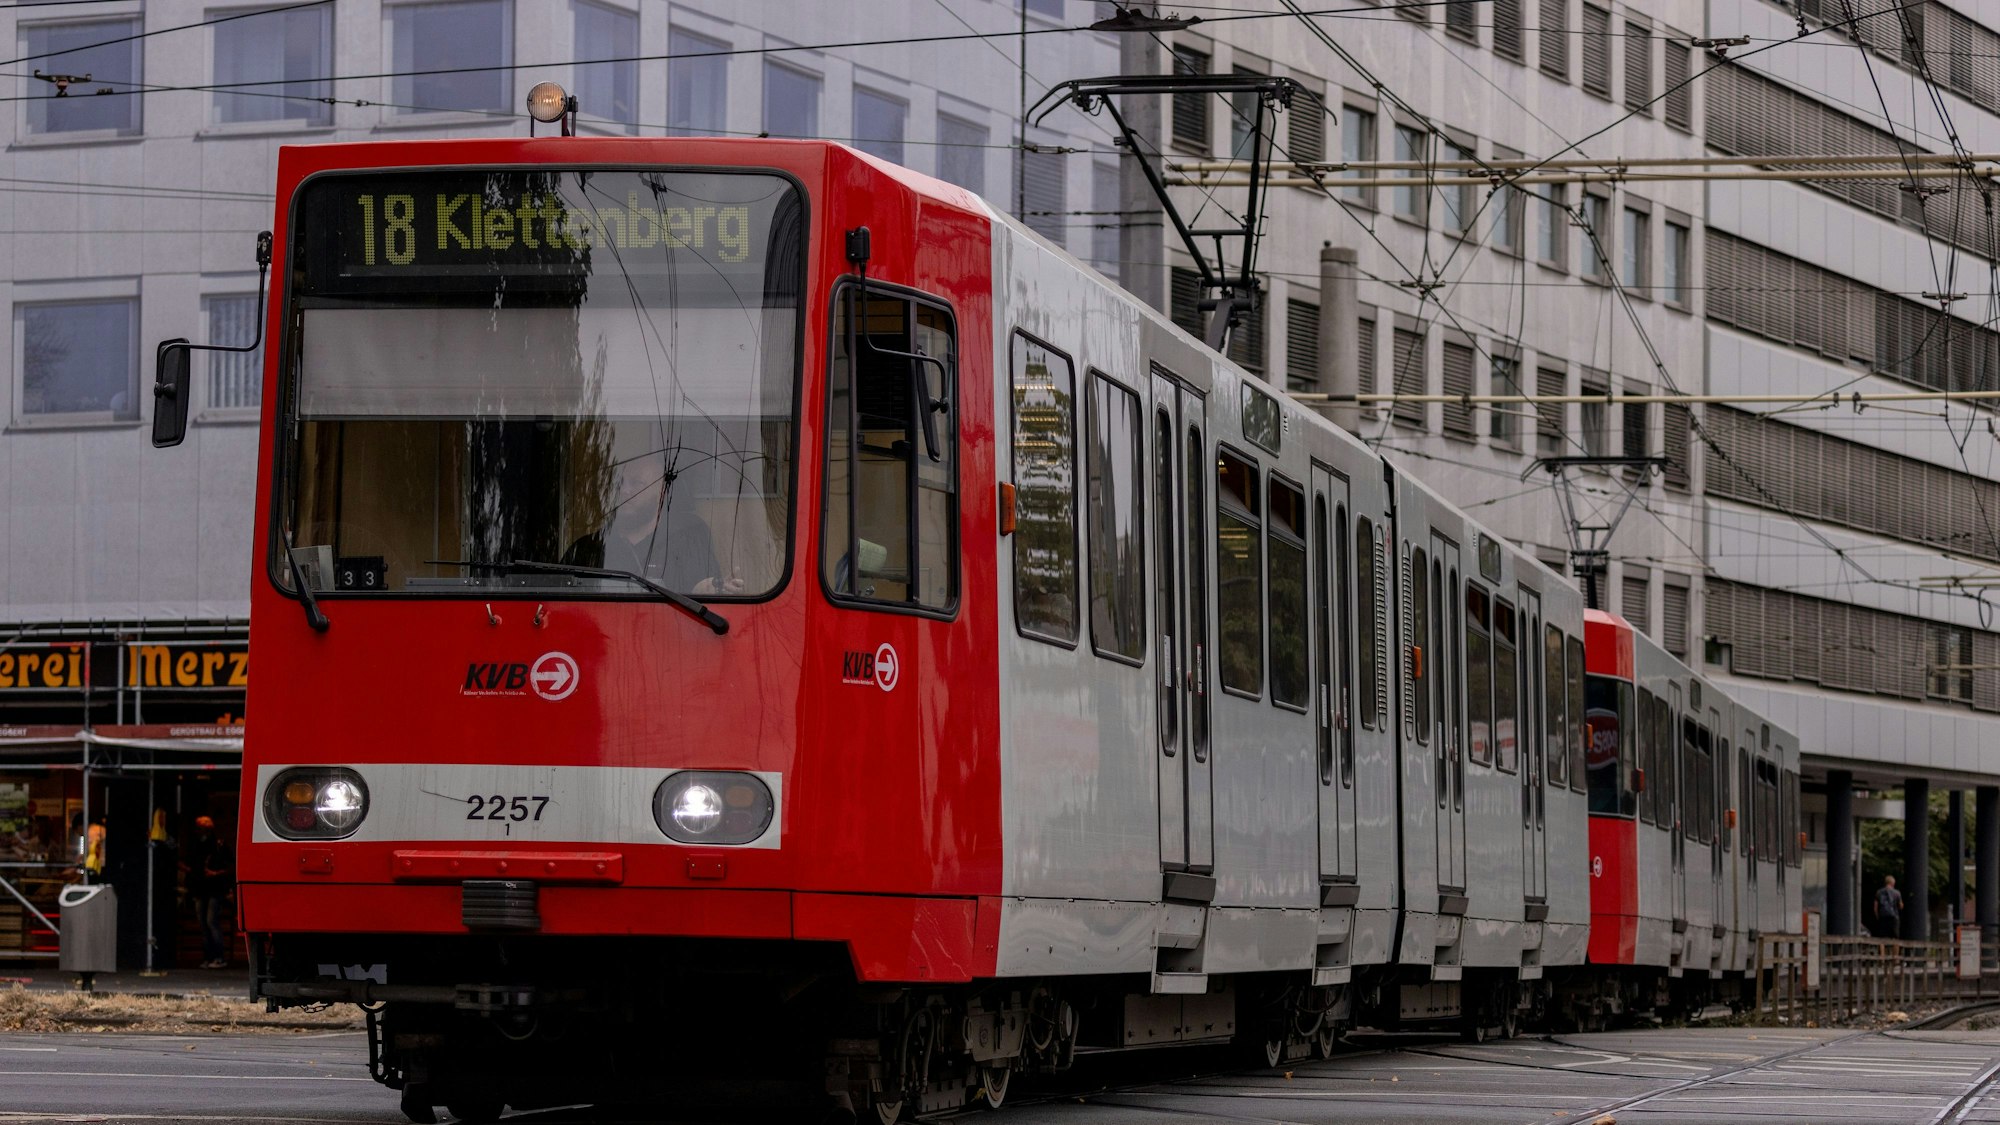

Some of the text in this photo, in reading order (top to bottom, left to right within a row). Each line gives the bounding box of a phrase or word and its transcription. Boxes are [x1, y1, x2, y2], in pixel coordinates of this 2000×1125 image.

[358, 190, 749, 266] 18 Klettenberg
[0, 645, 248, 687] erei Merz
[465, 664, 529, 689] KVB
[843, 652, 874, 678] KVB
[467, 795, 549, 821] 2257
[505, 823, 510, 836] 1
